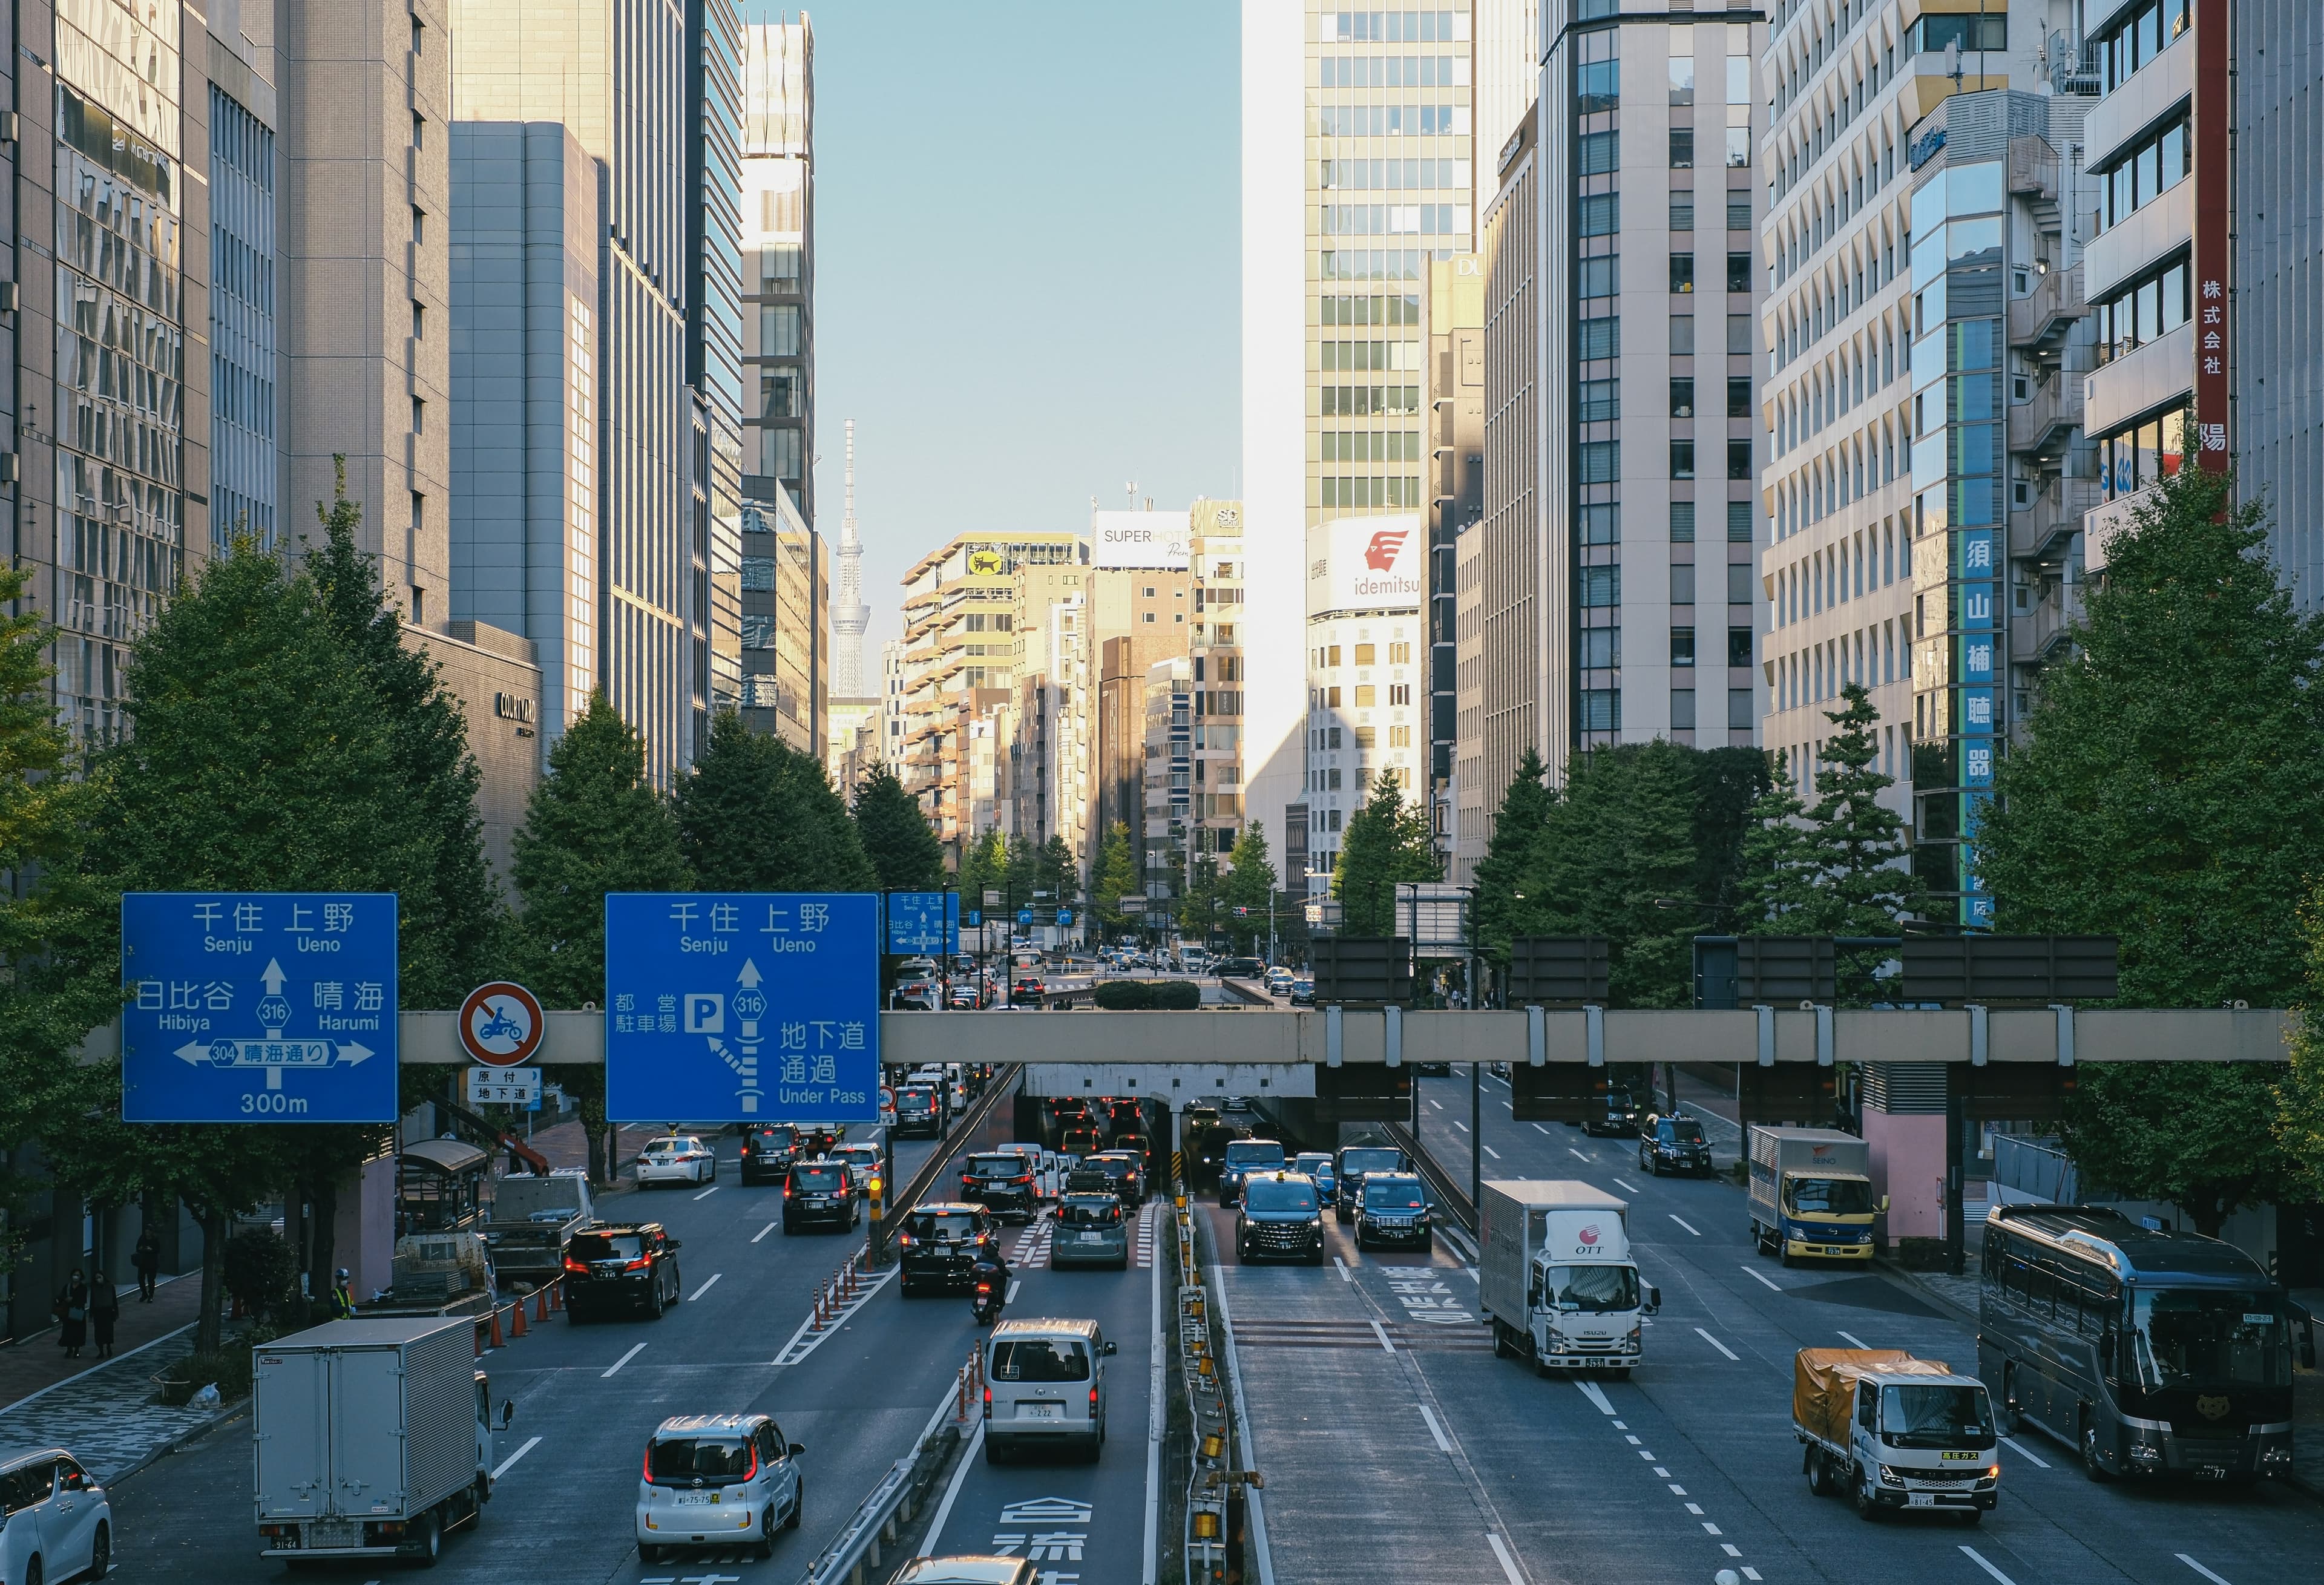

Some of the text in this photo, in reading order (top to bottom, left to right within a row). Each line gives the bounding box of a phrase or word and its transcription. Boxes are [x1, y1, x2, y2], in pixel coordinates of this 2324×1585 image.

[2202, 280, 2221, 375] 株式会社
[1104, 530, 1151, 542] SUPER
[1355, 576, 1419, 596] idemitsu
[1966, 540, 1991, 776] 須山補聴器
[501, 692, 536, 723] COURTYARD
[901, 896, 921, 905] 千住
[193, 903, 354, 933] 千住 上野
[669, 902, 829, 933] 千住 上野
[205, 935, 341, 954] Senju Ueno
[680, 936, 816, 955] Senju Ueno
[137, 980, 384, 1012] 日比谷 晴海
[615, 993, 677, 1012] 都営
[738, 996, 761, 1012] 316
[262, 1003, 286, 1020] 316
[694, 999, 717, 1029] P
[159, 1014, 380, 1031] Hibiya Harumi
[615, 1014, 677, 1033] 駐車場
[780, 1021, 866, 1049] 地下道
[212, 1046, 235, 1061] 304
[244, 1044, 323, 1063] 晴海通り
[478, 1072, 516, 1083] 原付
[780, 1054, 836, 1084] 通過
[478, 1088, 527, 1100] 地下道
[780, 1088, 866, 1104] Under Pass
[240, 1093, 309, 1115] 300m
[1575, 1246, 1604, 1255] OTT
